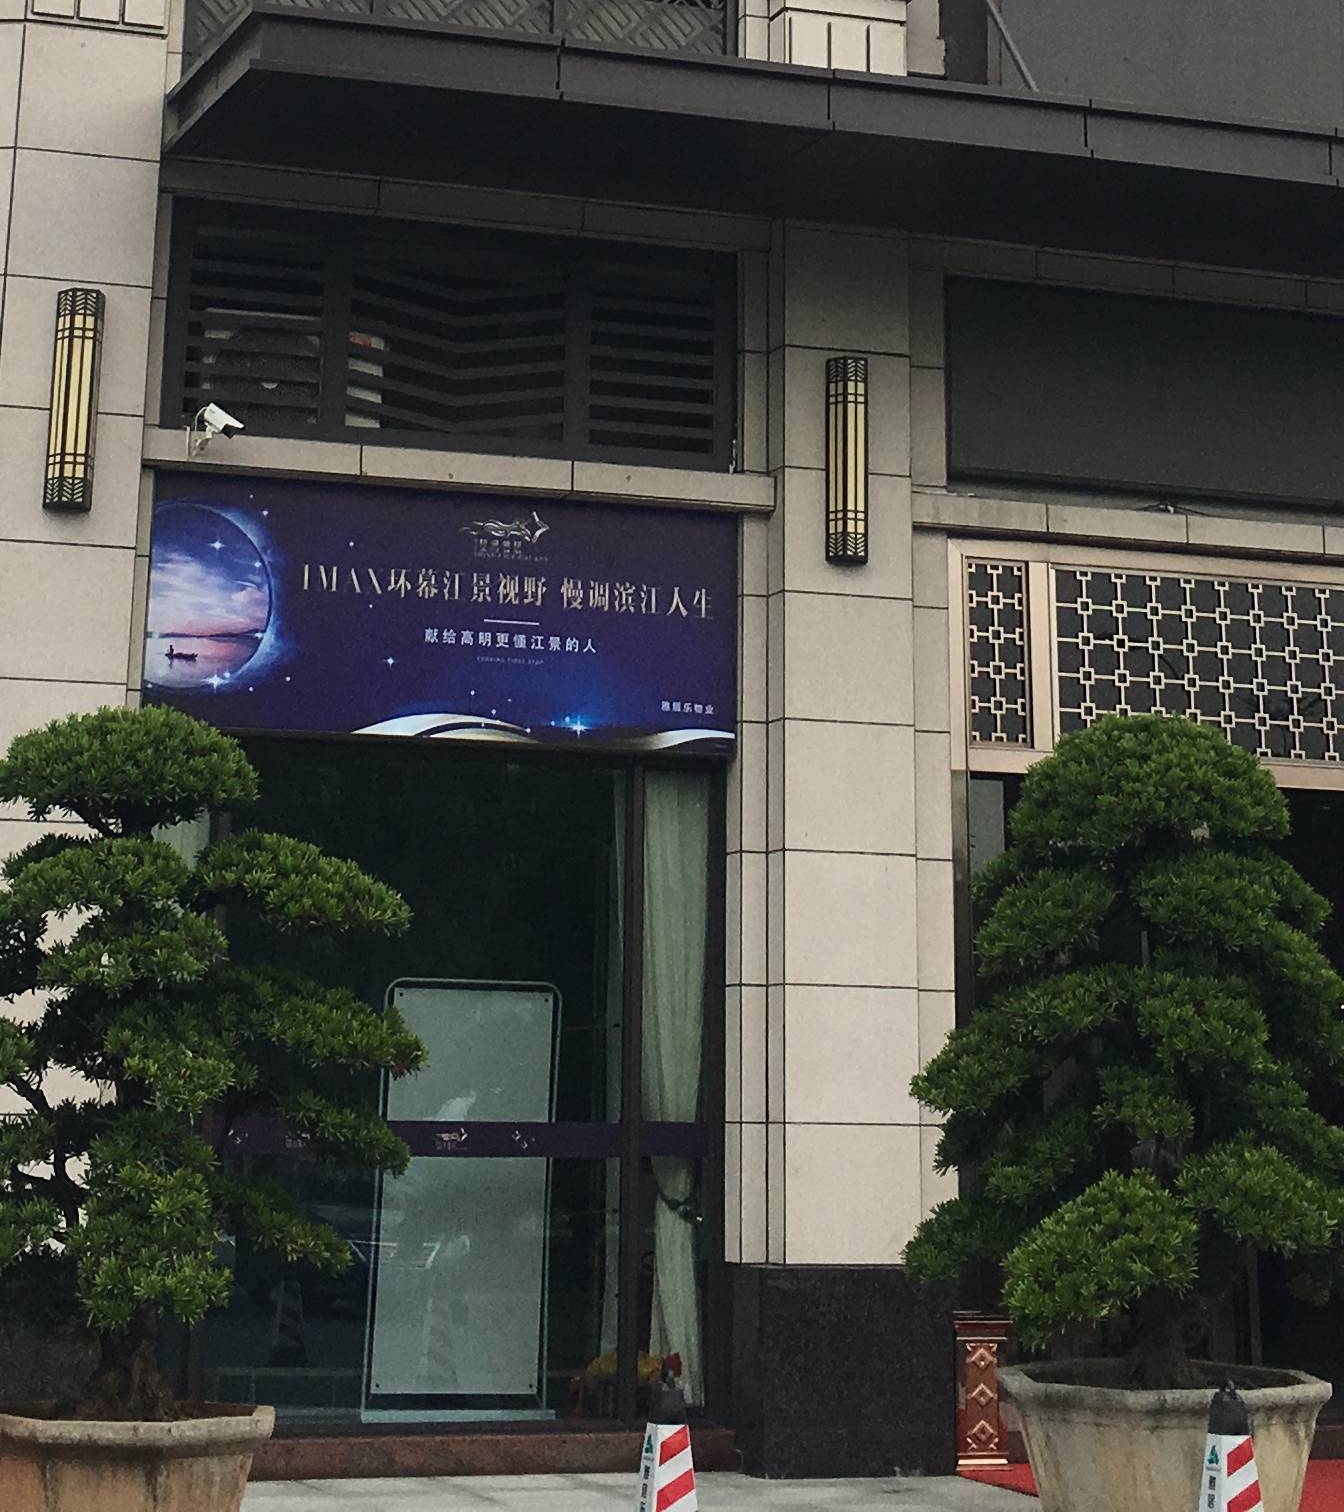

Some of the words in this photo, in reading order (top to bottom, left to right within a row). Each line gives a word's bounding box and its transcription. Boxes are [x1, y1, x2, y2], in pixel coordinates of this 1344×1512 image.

[560, 577, 714, 619] 慢调滨江人生
[424, 627, 597, 654] 献给高明更懂江景的人
